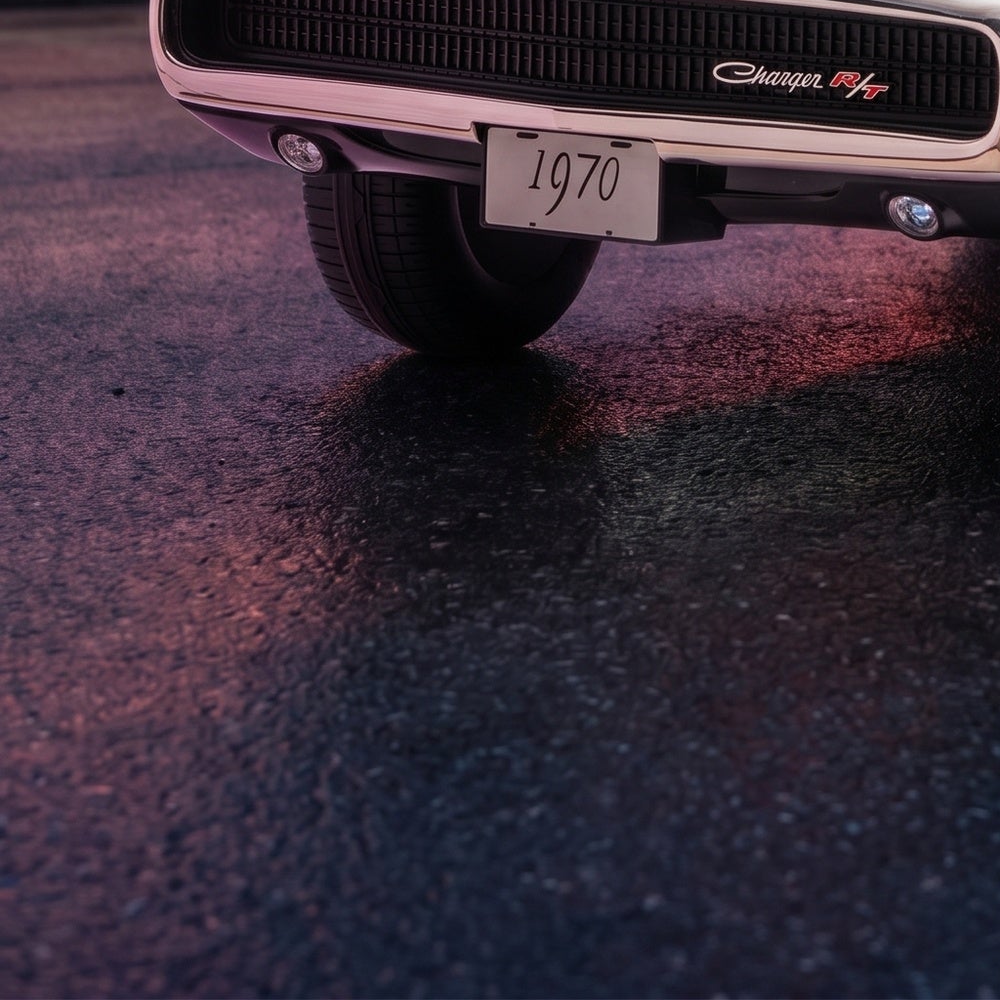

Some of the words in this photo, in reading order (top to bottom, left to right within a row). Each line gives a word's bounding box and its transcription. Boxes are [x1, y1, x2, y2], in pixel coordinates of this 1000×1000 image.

[712, 61, 824, 94] Charger
[829, 71, 890, 100] R/T
[528, 149, 620, 217] 1970
